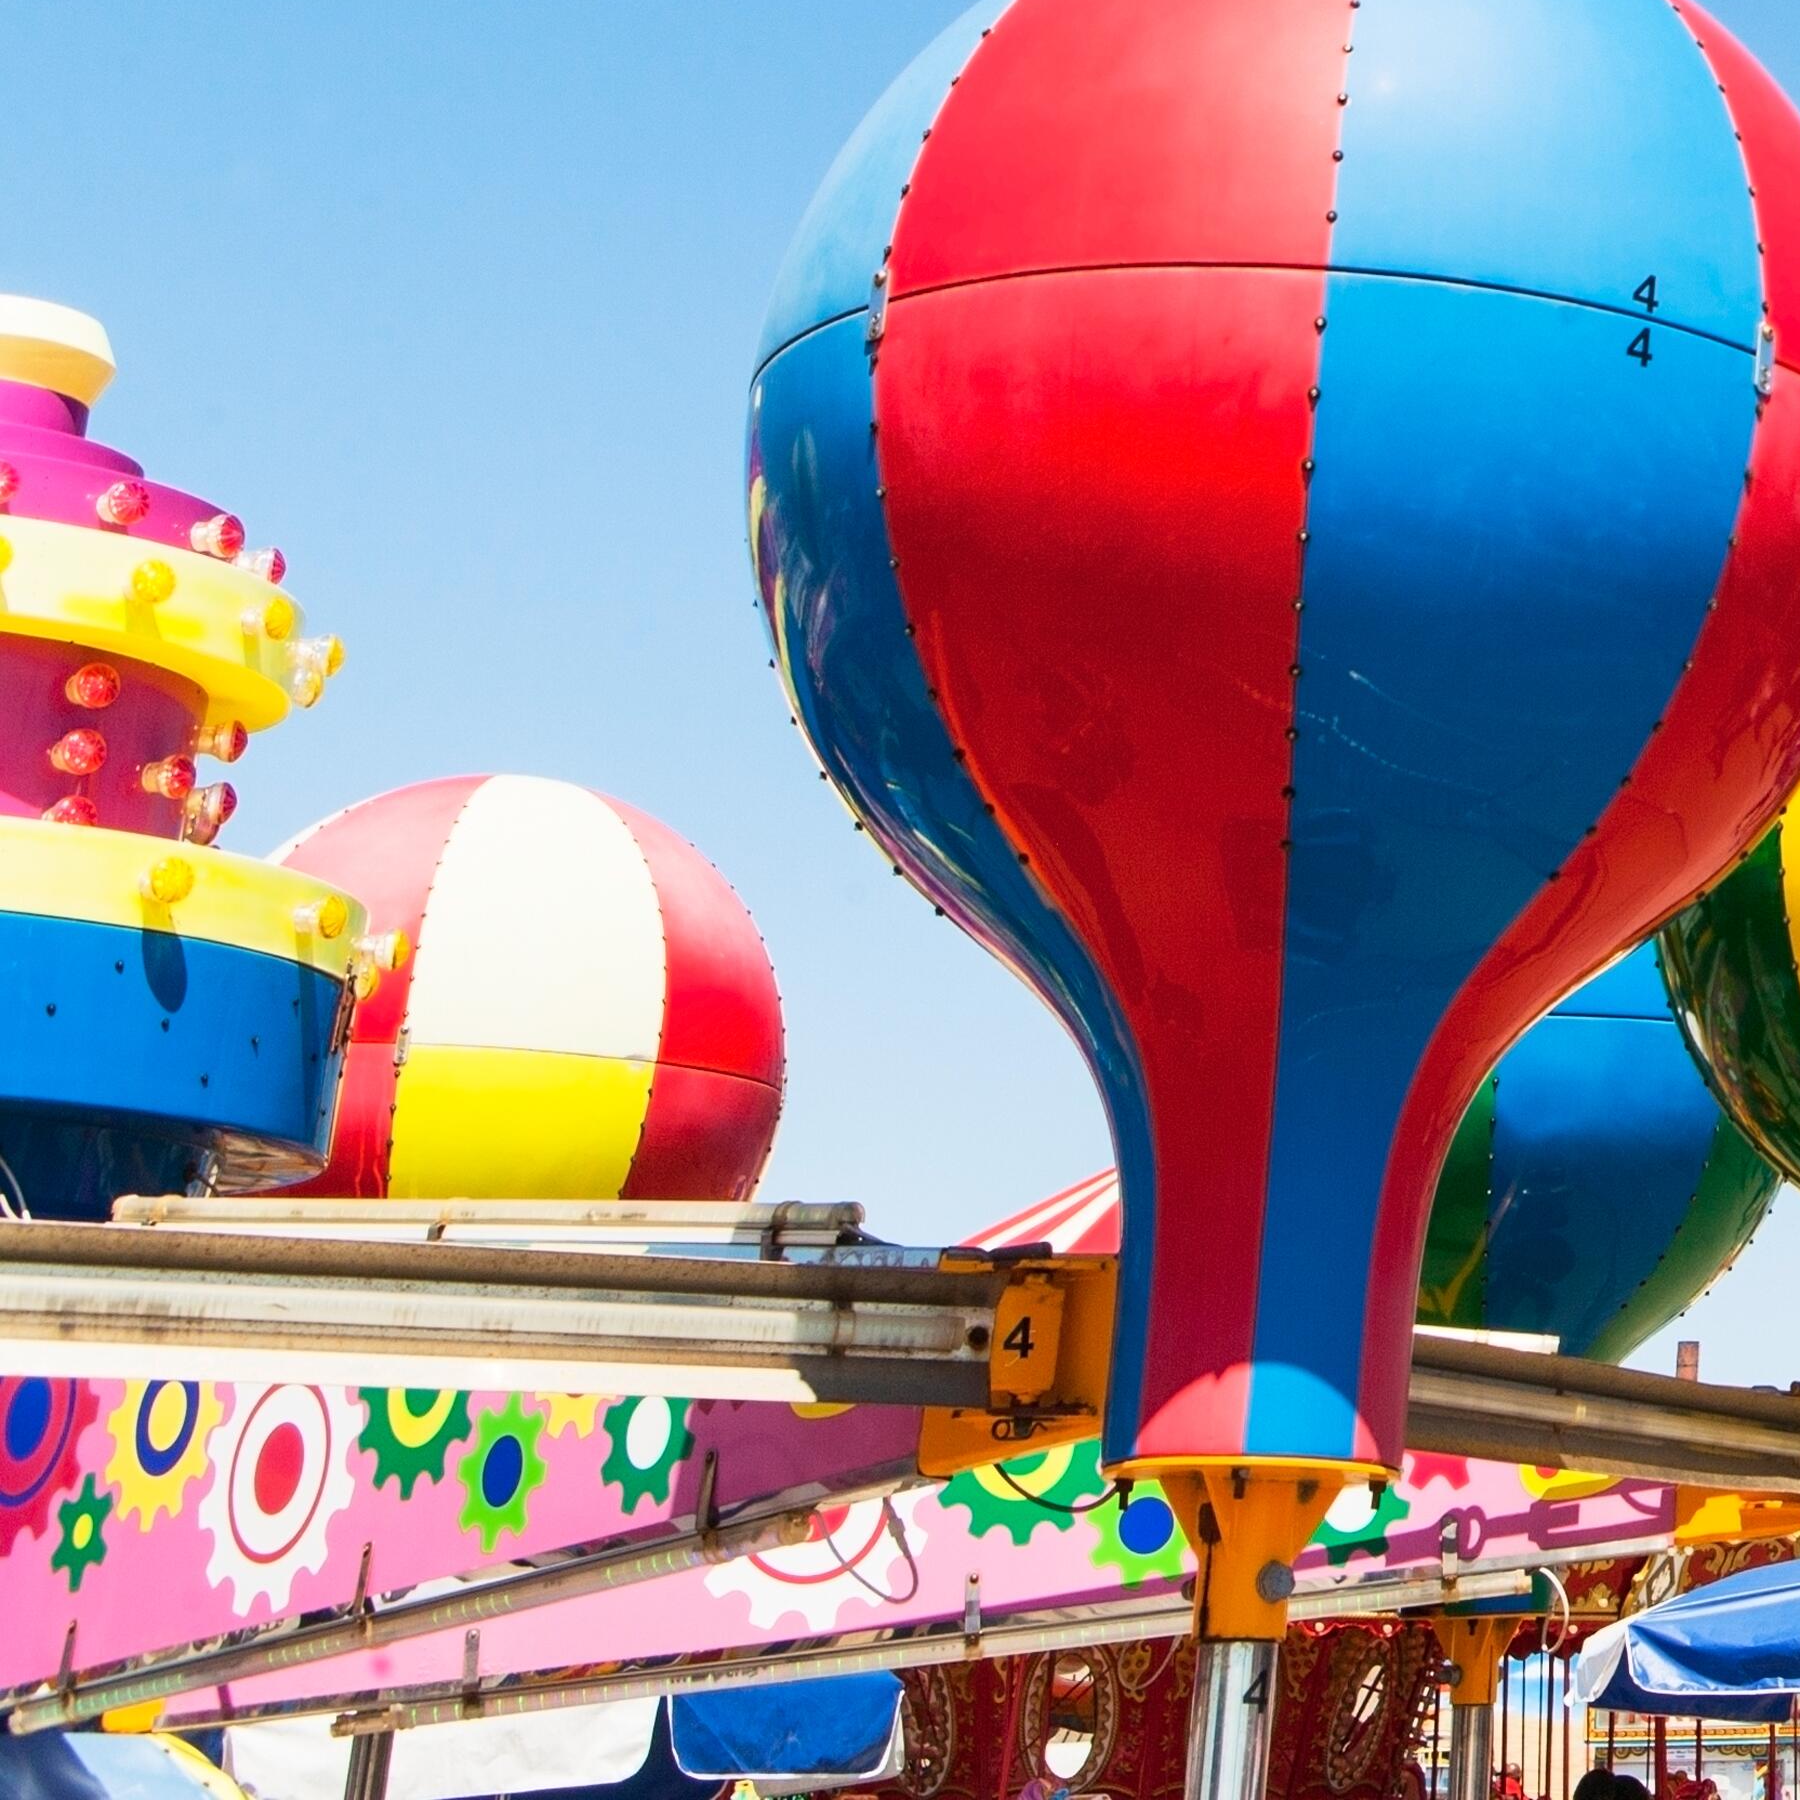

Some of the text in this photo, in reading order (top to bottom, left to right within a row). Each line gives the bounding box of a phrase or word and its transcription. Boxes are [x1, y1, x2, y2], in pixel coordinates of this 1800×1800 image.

[1632, 274, 1659, 314] 4
[1626, 327, 1653, 368] 4
[1003, 1316, 1034, 1358] 4
[1243, 1671, 1268, 1714] 4
